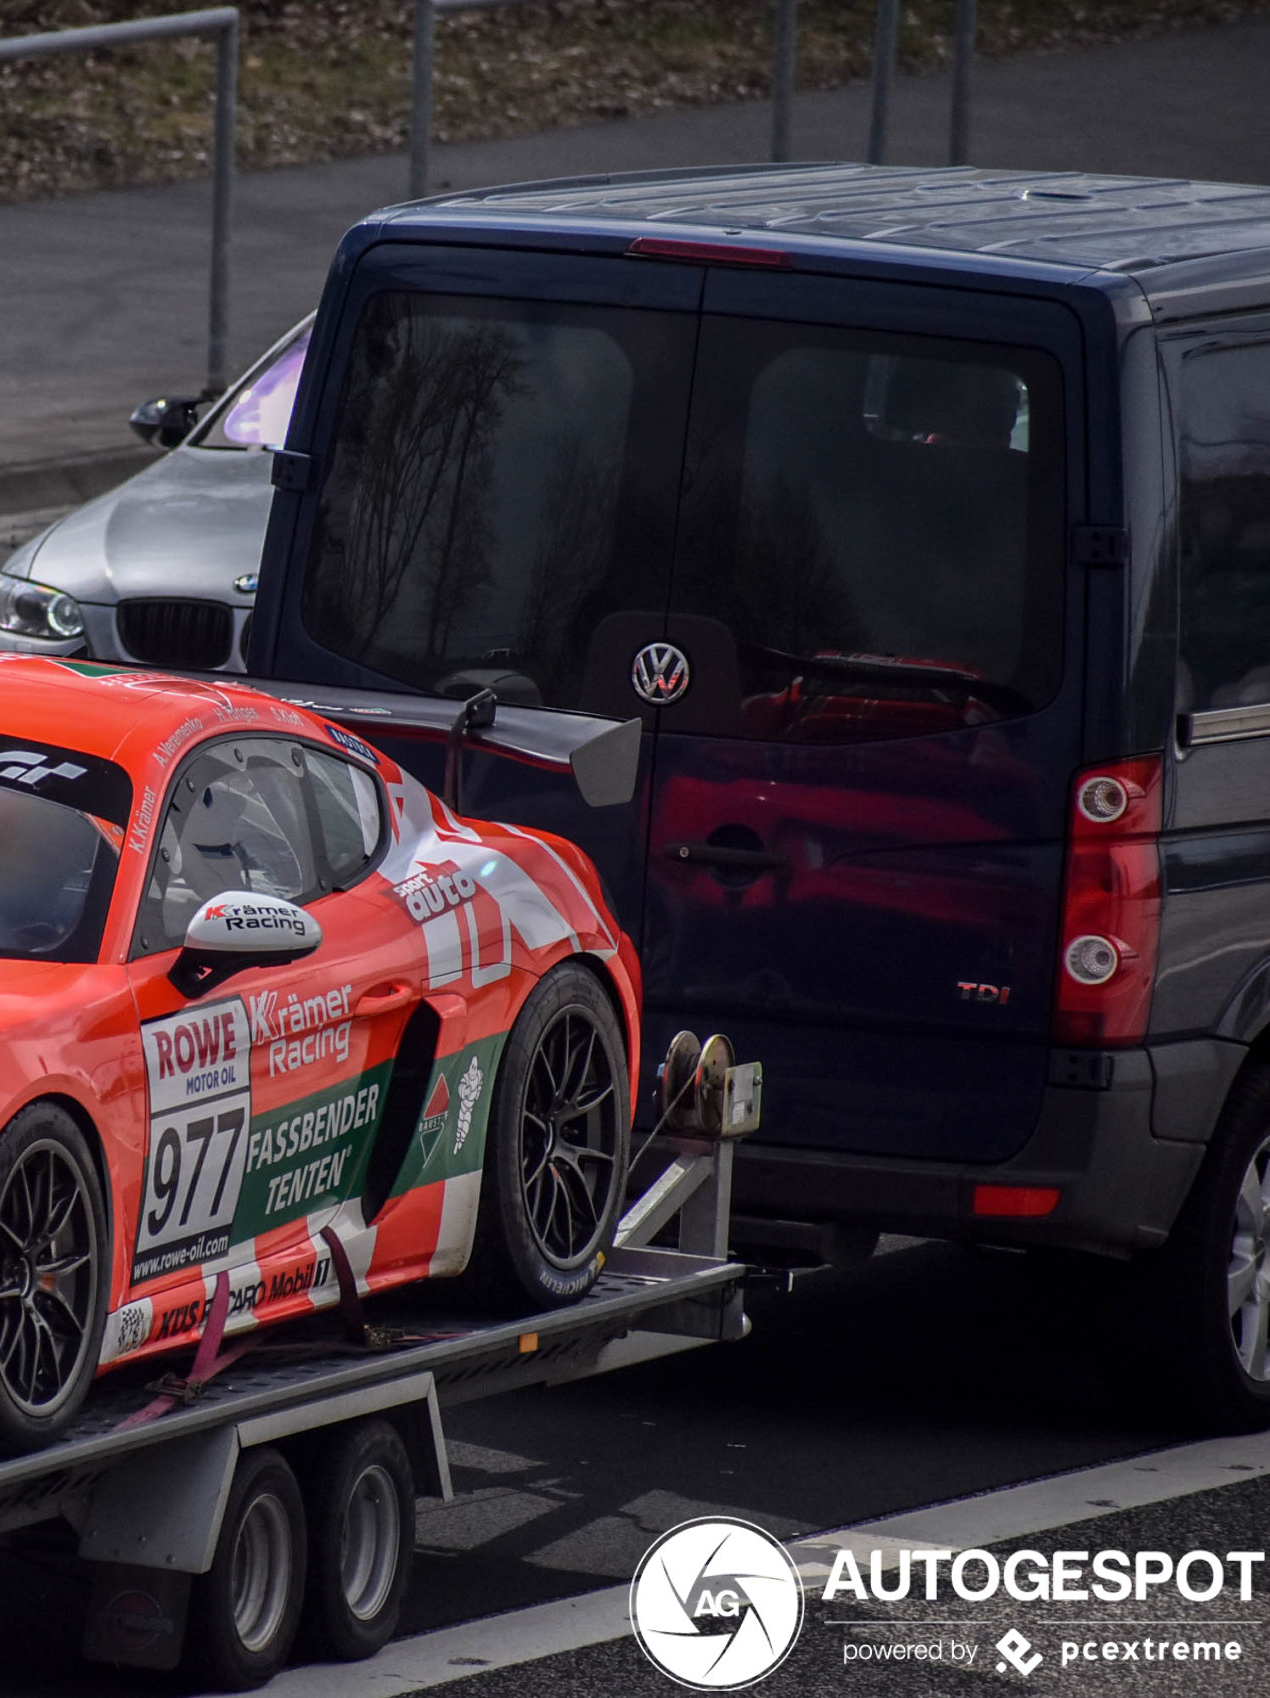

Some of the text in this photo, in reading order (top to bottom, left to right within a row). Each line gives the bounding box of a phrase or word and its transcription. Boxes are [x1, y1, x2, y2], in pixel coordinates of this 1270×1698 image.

[393, 871, 434, 898] sport
[406, 871, 478, 922] auto
[205, 904, 299, 921] Krämer
[225, 915, 306, 936] Racing
[957, 981, 1011, 1005] TDI
[249, 985, 352, 1046] Krämer
[151, 1011, 237, 1079] ROWE
[270, 1020, 352, 1078] Racing
[186, 1065, 236, 1095] MOTOR OIL
[246, 1083, 380, 1174] FASSBENDER
[147, 1107, 245, 1236] 977
[133, 1235, 229, 1280] www.rowe-oil.com
[268, 1260, 314, 1303] Mobil
[539, 1271, 590, 1295] MICHELIN
